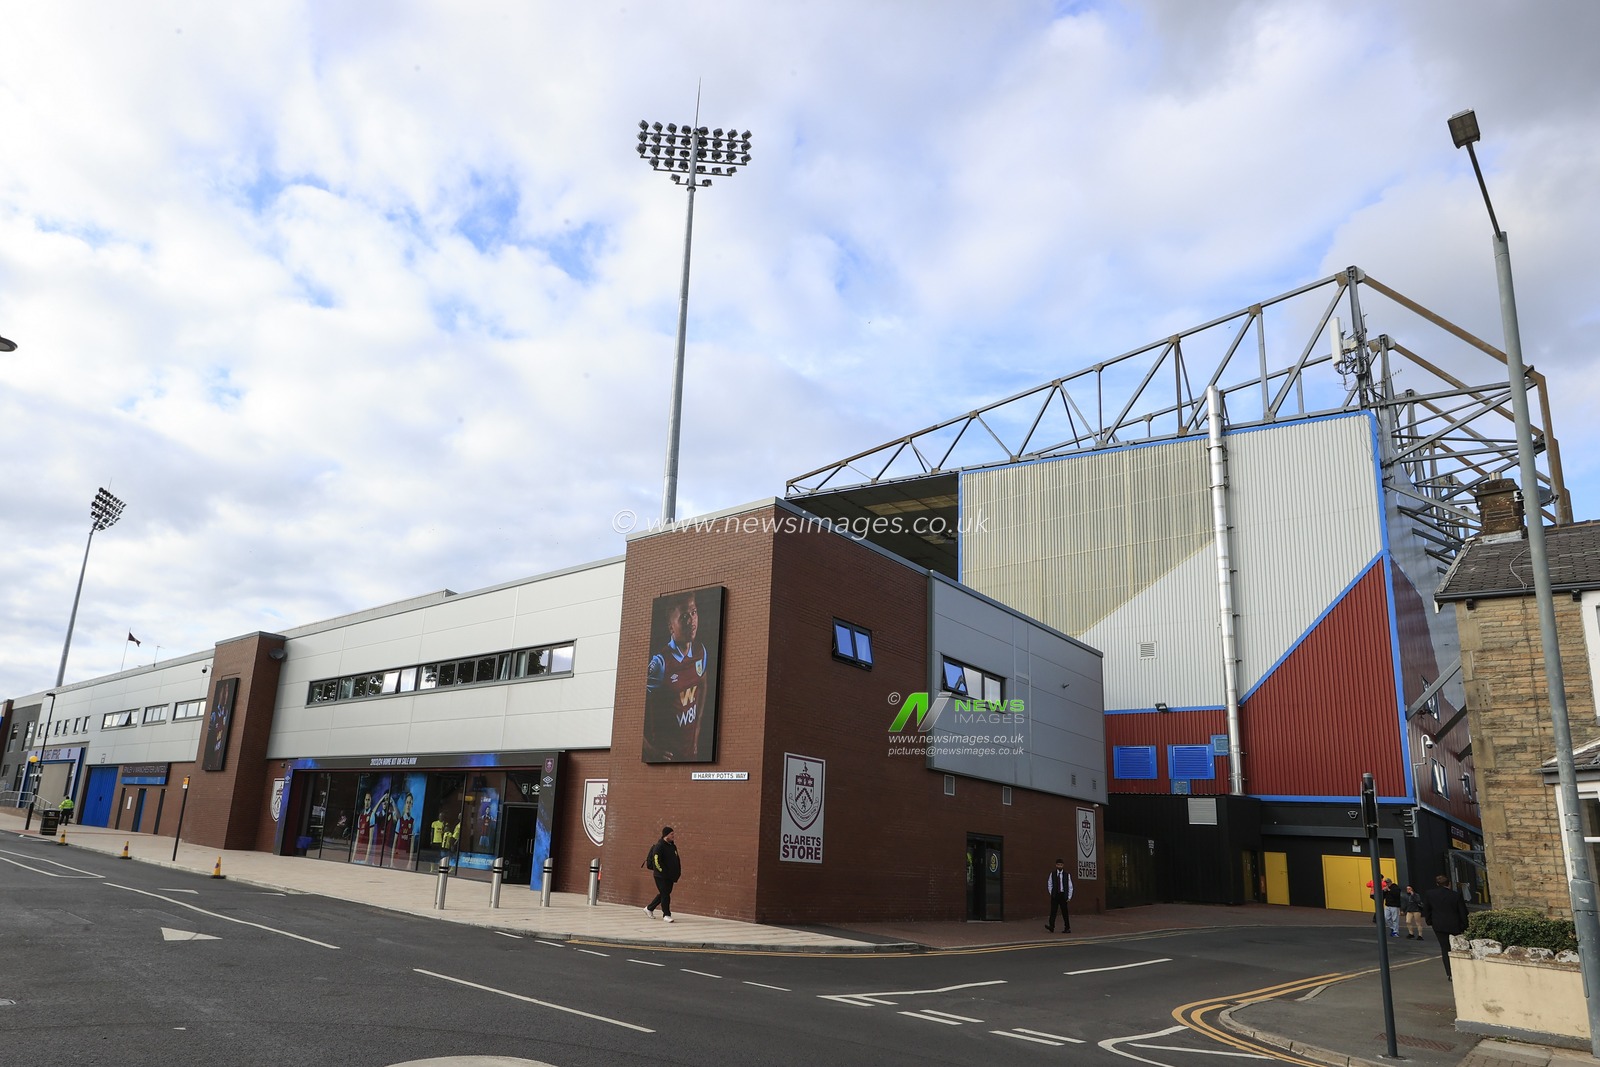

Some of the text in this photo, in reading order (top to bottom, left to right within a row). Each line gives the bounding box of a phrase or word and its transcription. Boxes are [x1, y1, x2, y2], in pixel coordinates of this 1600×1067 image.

[782, 834, 822, 847] CLARETS
[782, 845, 821, 860] STORE
[1078, 868, 1096, 878] STORE
